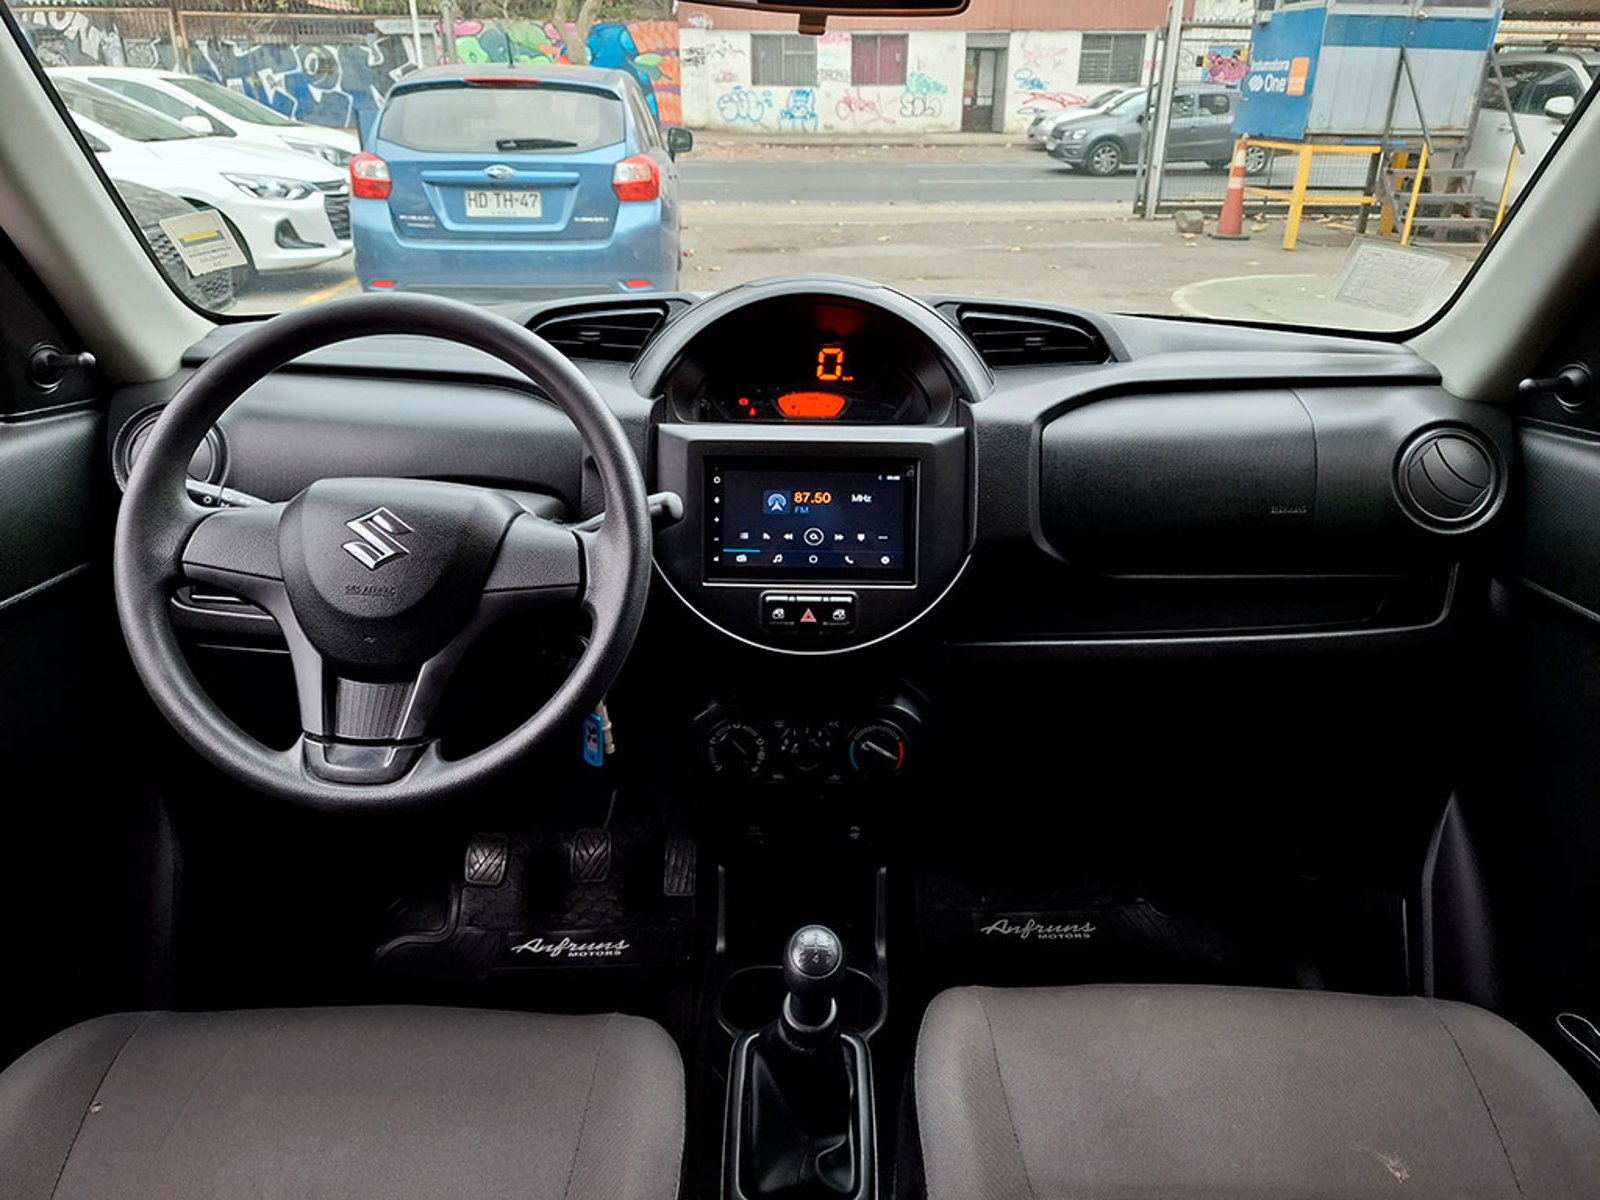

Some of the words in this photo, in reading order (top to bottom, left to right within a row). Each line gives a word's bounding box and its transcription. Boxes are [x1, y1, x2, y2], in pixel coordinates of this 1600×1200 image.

[1264, 73, 1287, 92] One
[816, 347, 844, 380] 0
[794, 491, 832, 504] 87.50
[851, 494, 872, 503] MHz
[794, 506, 809, 514] FM
